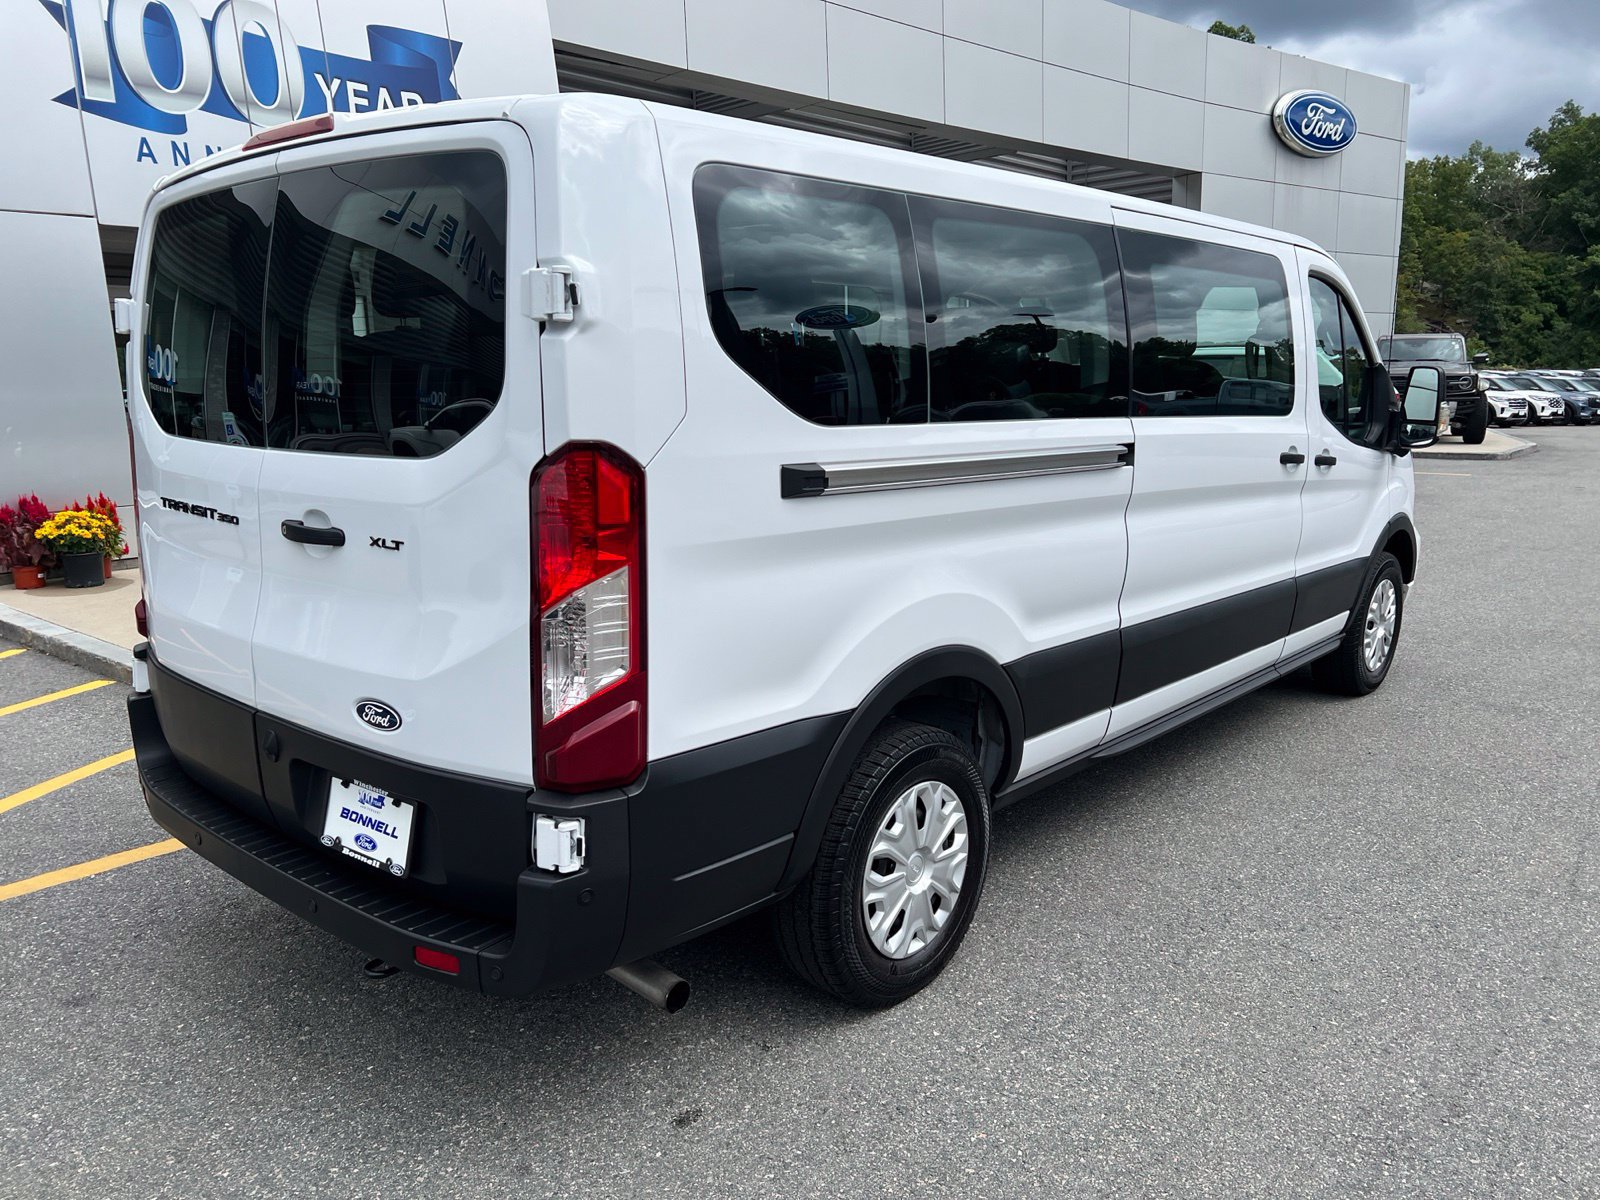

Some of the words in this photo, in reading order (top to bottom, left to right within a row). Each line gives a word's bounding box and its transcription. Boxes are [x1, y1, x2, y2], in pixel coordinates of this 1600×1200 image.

[68, 0, 305, 128] 100
[1301, 102, 1346, 142] Ford
[369, 535, 405, 551] XLT
[362, 704, 391, 727] Ford
[353, 779, 389, 797] Winchester
[340, 806, 398, 840] BONNELL
[357, 834, 375, 851] Ford
[341, 847, 380, 869] Bonnell
